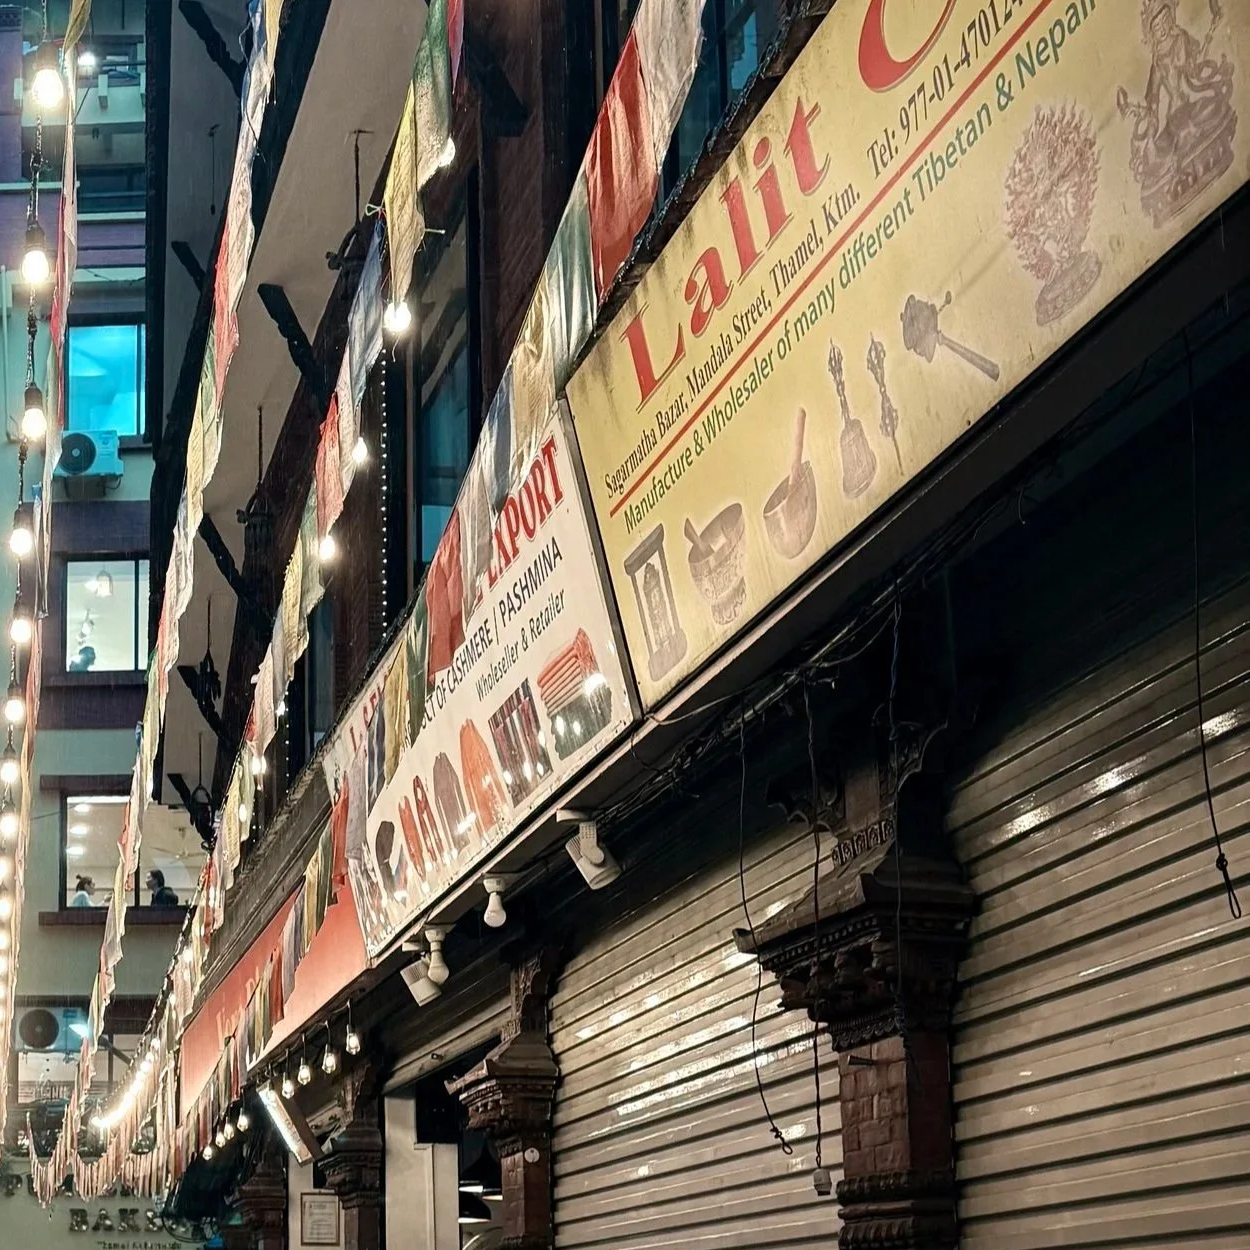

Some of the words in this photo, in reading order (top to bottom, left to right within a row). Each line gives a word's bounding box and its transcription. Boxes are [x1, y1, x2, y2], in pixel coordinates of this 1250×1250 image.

[604, 429, 658, 498] Sagarmatha
[656, 392, 690, 442] Bazar,
[686, 333, 734, 402] Mandala
[732, 288, 773, 345] Street,
[769, 219, 825, 298] Thamel,
[821, 183, 861, 236] Ktm.
[866, 127, 899, 180] Tel:
[899, 0, 1023, 144] 977-01-47012
[619, 95, 831, 413] Lalit
[624, 454, 694, 534] Manufacture
[694, 429, 705, 457] &
[702, 350, 773, 444] Wholesaler
[777, 321, 791, 360] of
[794, 284, 835, 343] many
[839, 187, 914, 290] different
[911, 101, 992, 202] Tibetan
[995, 72, 1014, 112] &
[436, 677, 446, 710] OF
[446, 618, 493, 694] CASHMERE
[498, 536, 563, 628] PASHMINA
[475, 641, 519, 702] Wholeseller
[520, 627, 529, 652] &
[529, 588, 565, 643] Retailer
